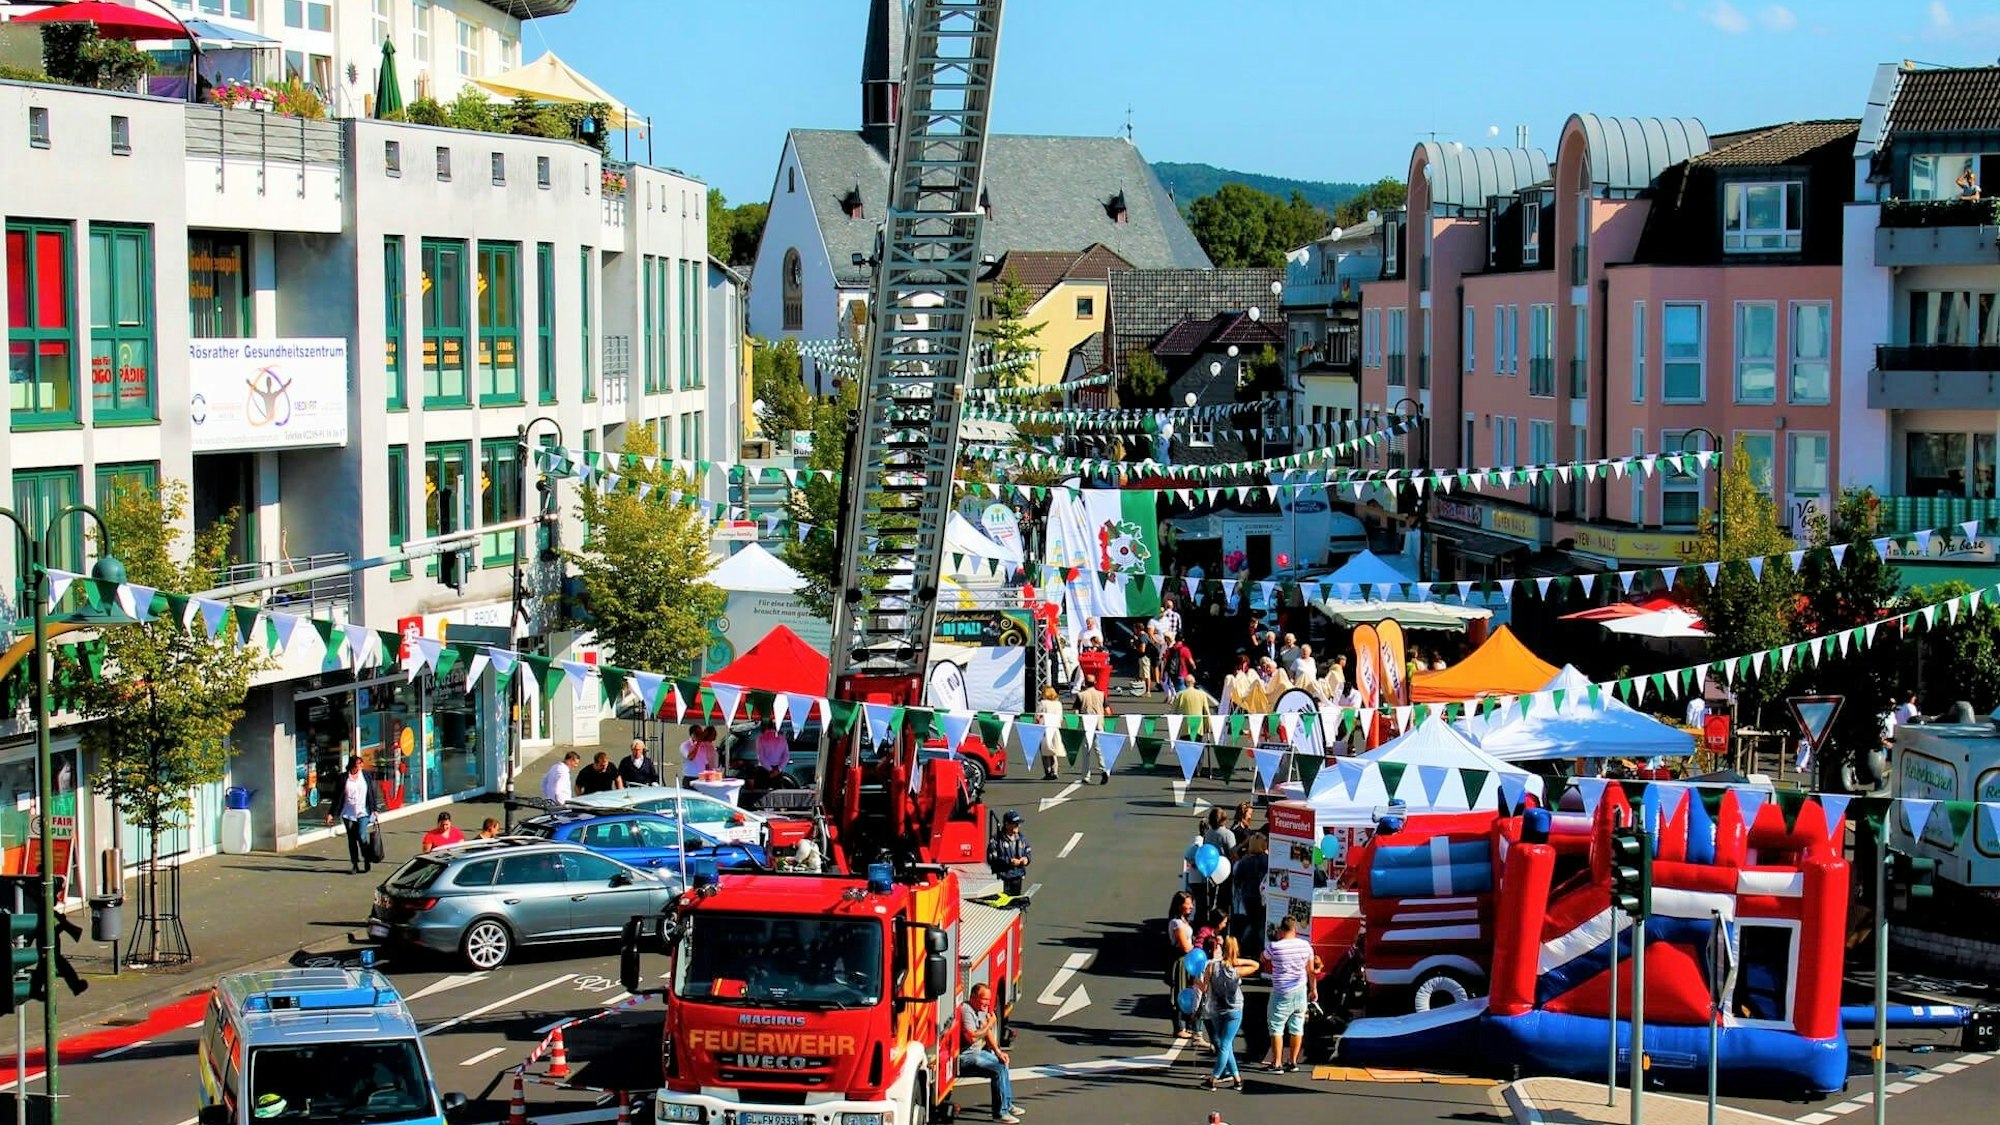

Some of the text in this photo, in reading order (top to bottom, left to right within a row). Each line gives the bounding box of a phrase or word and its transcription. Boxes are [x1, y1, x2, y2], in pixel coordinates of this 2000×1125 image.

[190, 344, 344, 358] Rösrather Gesundheitszentrum
[753, 607, 780, 615] braucht
[943, 622, 956, 635] DJ
[52, 816, 73, 826] FAIR
[51, 827, 72, 837] PLAY
[738, 1013, 806, 1026] MAGIRUS
[689, 1030, 855, 1055] FEUERWEHR
[736, 1053, 806, 1070] IVECO
